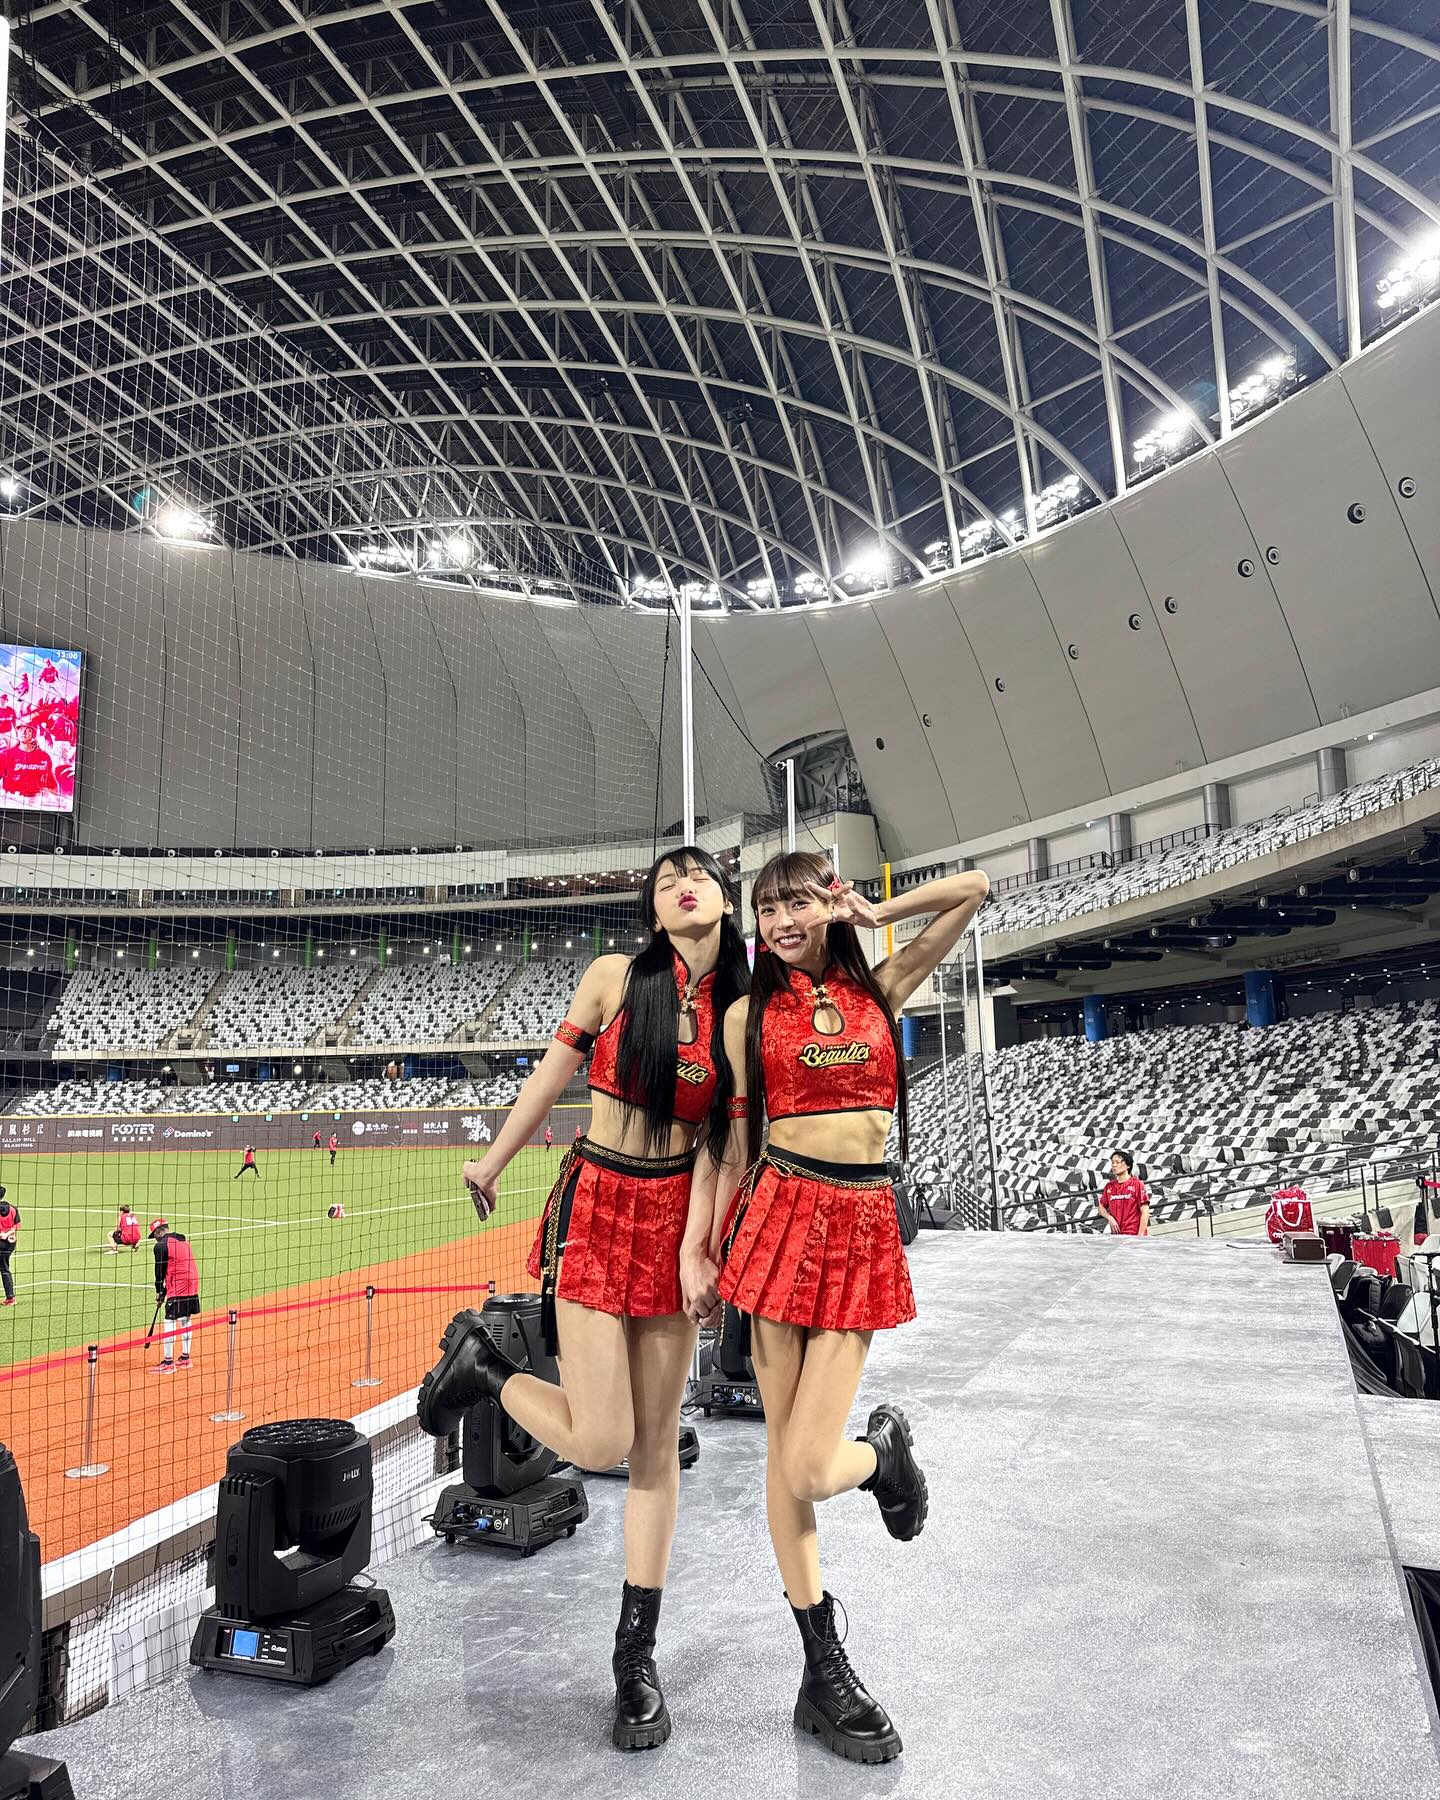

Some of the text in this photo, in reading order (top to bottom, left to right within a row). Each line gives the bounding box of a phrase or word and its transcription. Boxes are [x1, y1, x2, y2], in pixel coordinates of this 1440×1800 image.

[799, 1042, 871, 1068] Beauties
[111, 1123, 155, 1135] FOOTER
[174, 1129, 212, 1138] Domino's
